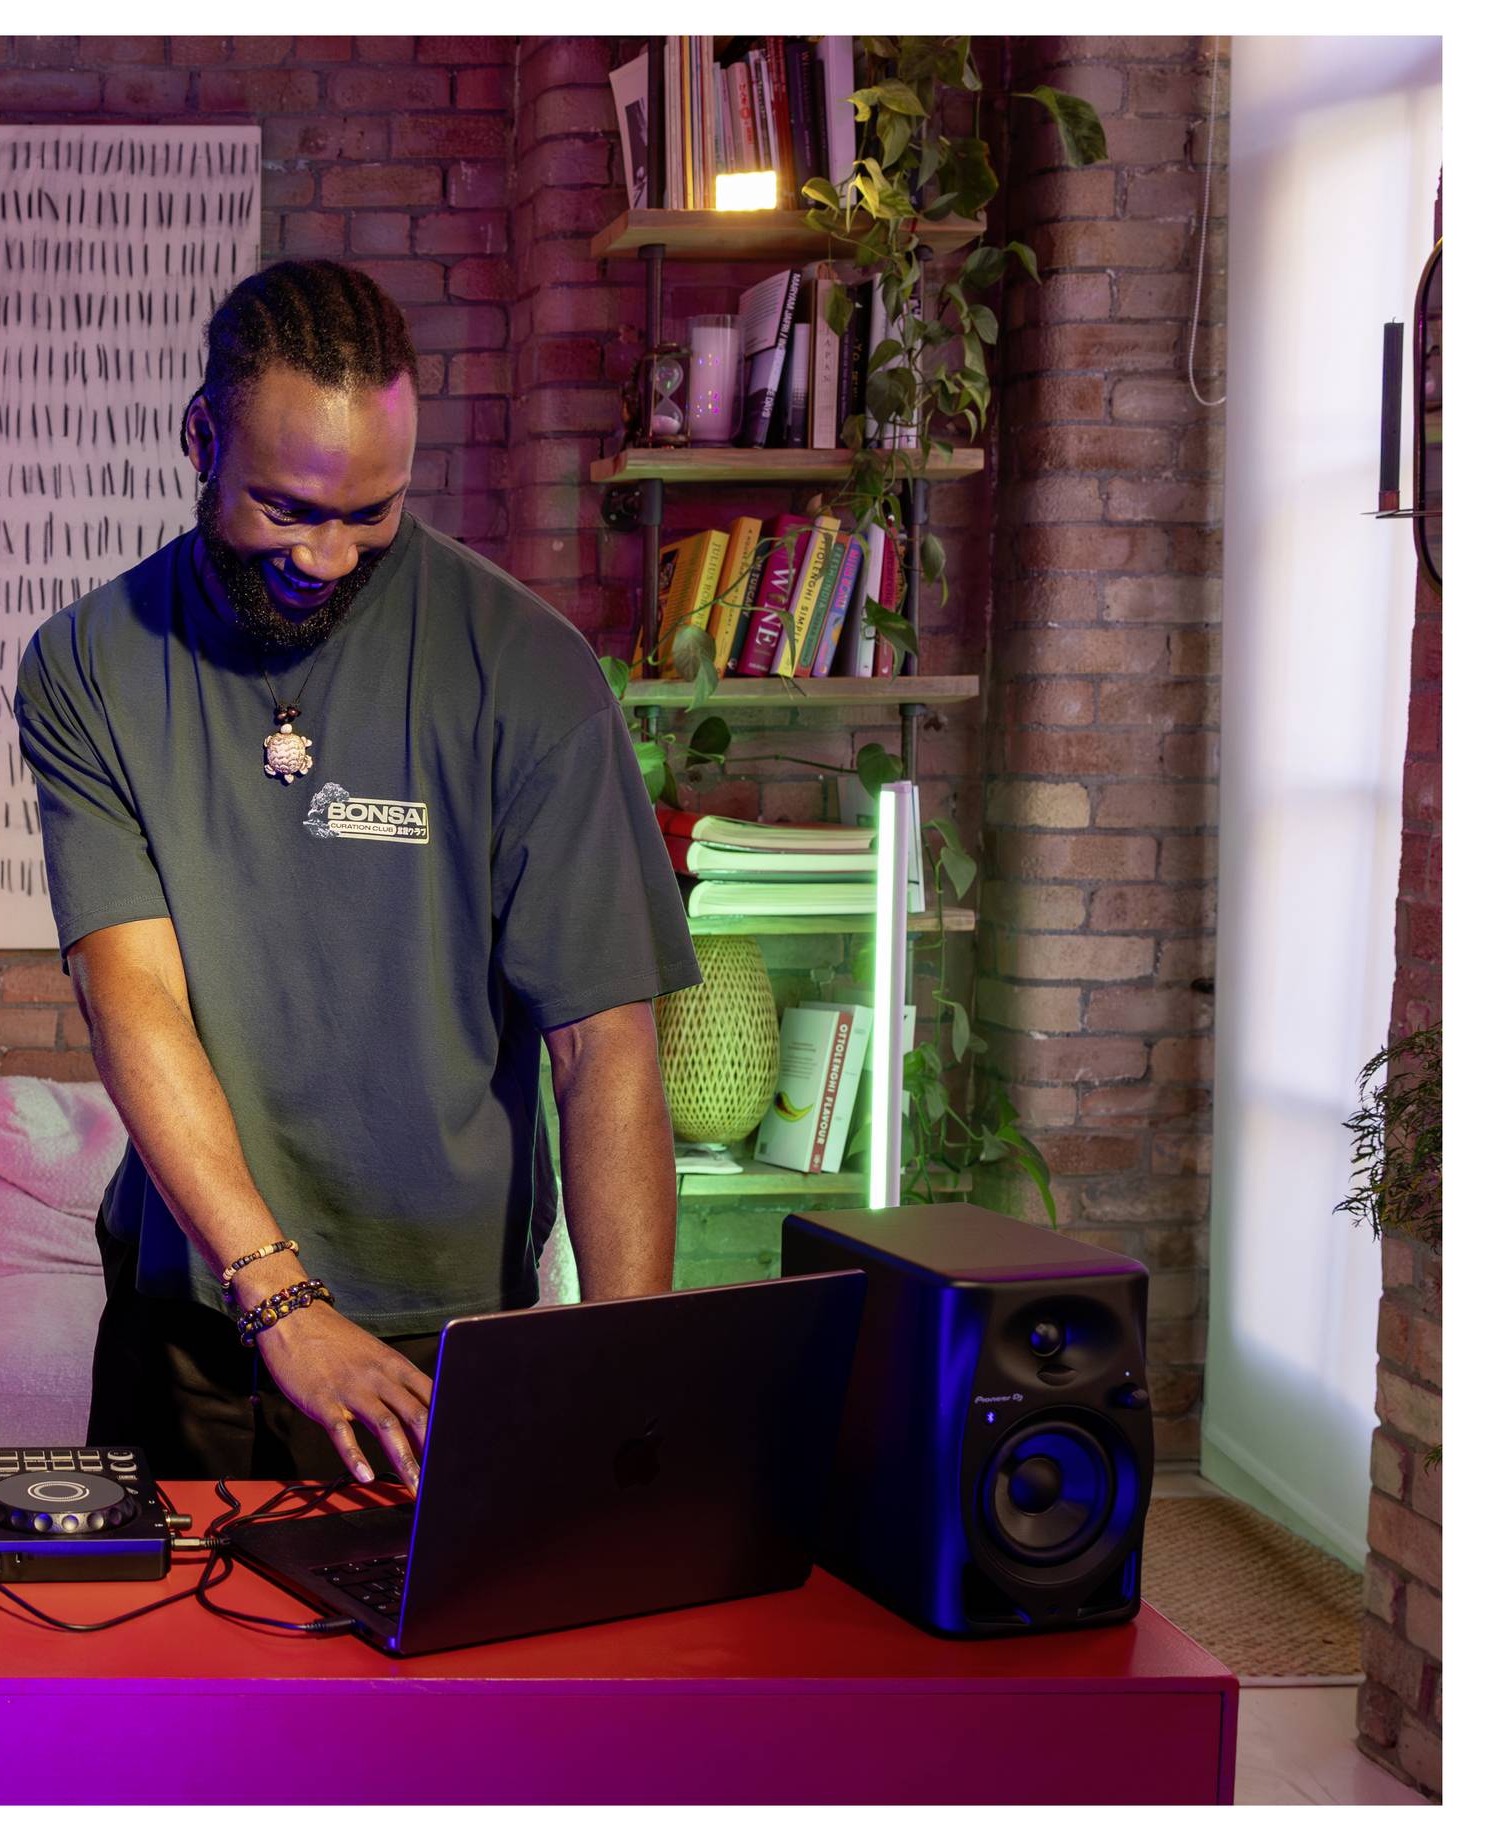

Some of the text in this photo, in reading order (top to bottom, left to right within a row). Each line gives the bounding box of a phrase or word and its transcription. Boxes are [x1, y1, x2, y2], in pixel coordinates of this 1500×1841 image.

[784, 273, 801, 310] MARYAM
[780, 311, 794, 333] JAFRI
[806, 540, 827, 600] TTOLENGHI
[827, 546, 843, 577] FRESH
[695, 542, 721, 627] JULIUS ROBRT
[818, 580, 834, 609] INDIA
[328, 802, 426, 826] BONSAI
[331, 823, 371, 831] CURATION
[817, 1024, 848, 1145] OTTOLENGHI FLAVOUR
[974, 1395, 1011, 1404] Pioneer
